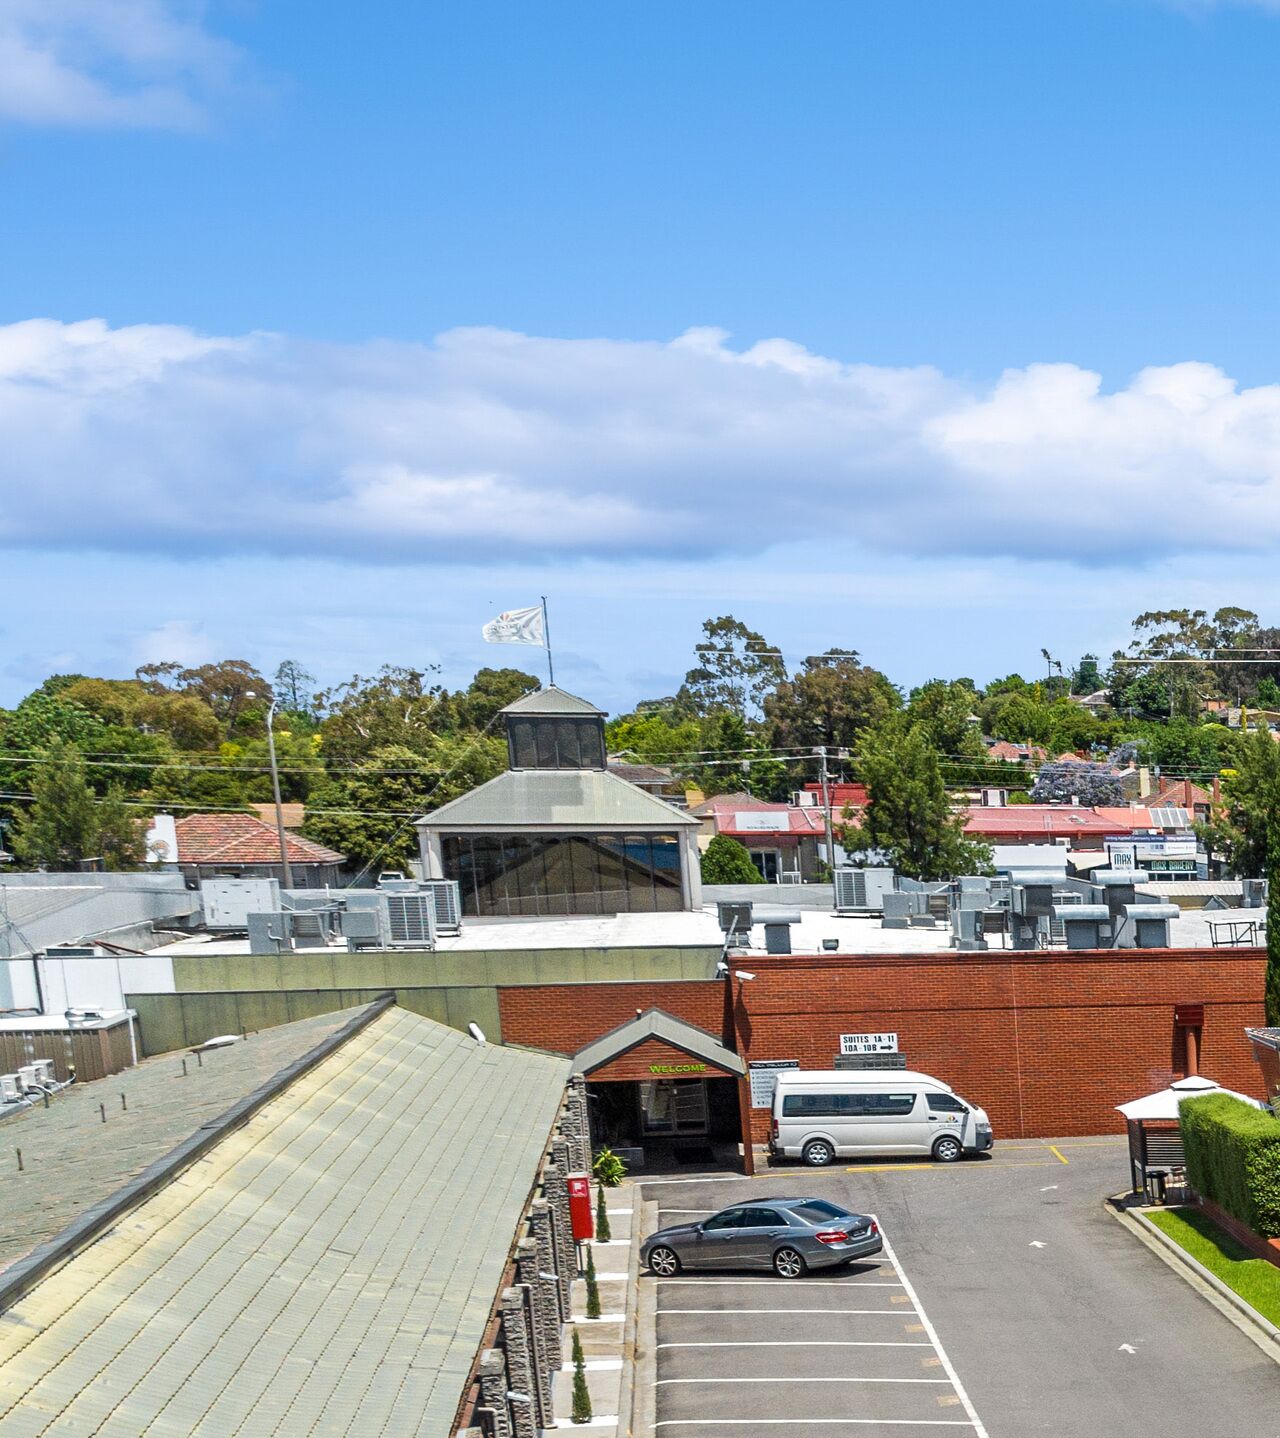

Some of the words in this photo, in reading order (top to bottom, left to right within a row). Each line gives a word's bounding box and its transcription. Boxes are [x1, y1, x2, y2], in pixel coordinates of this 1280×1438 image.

[1114, 853, 1132, 865] MAX
[843, 1036, 869, 1044] SUITES
[648, 1063, 706, 1073] WELCOME
